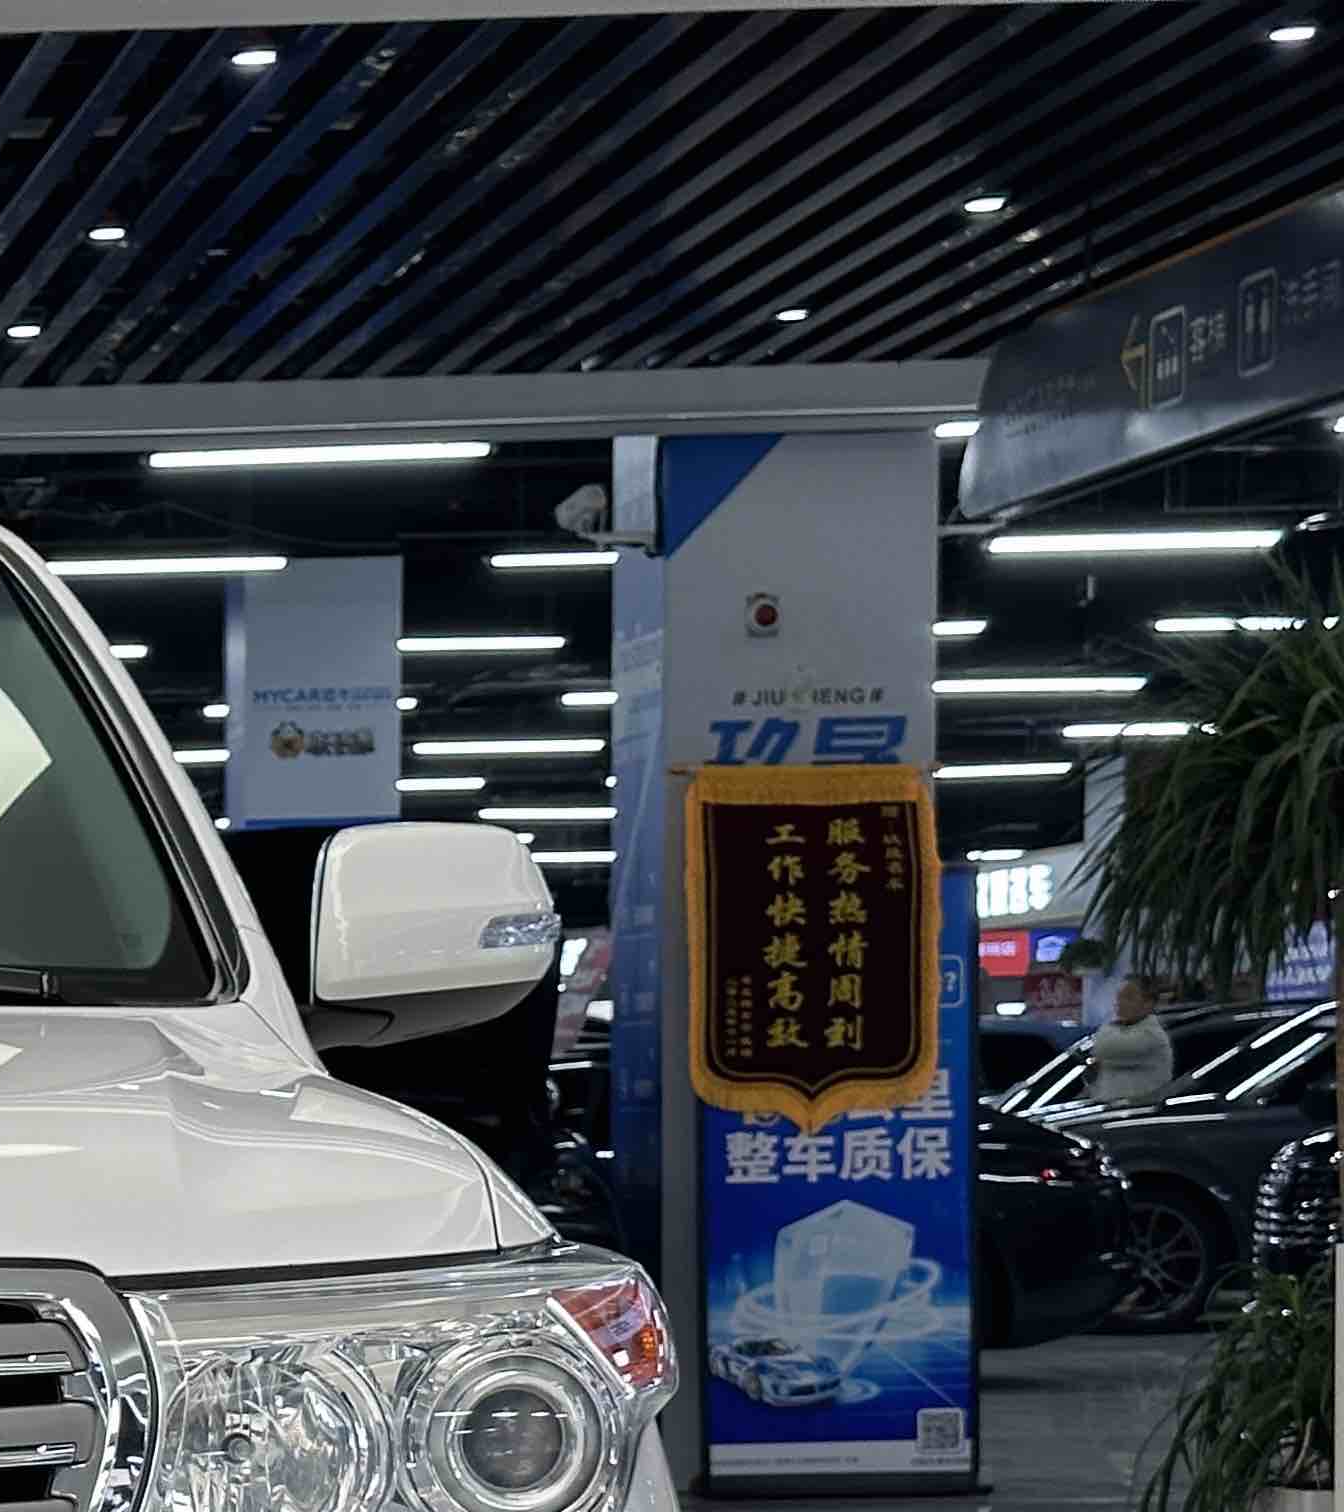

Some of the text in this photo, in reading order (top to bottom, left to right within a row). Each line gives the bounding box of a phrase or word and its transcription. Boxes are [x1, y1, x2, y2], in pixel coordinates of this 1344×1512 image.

[824, 817, 871, 1050] 服务热情周到
[725, 1127, 954, 1185] 整车质保
